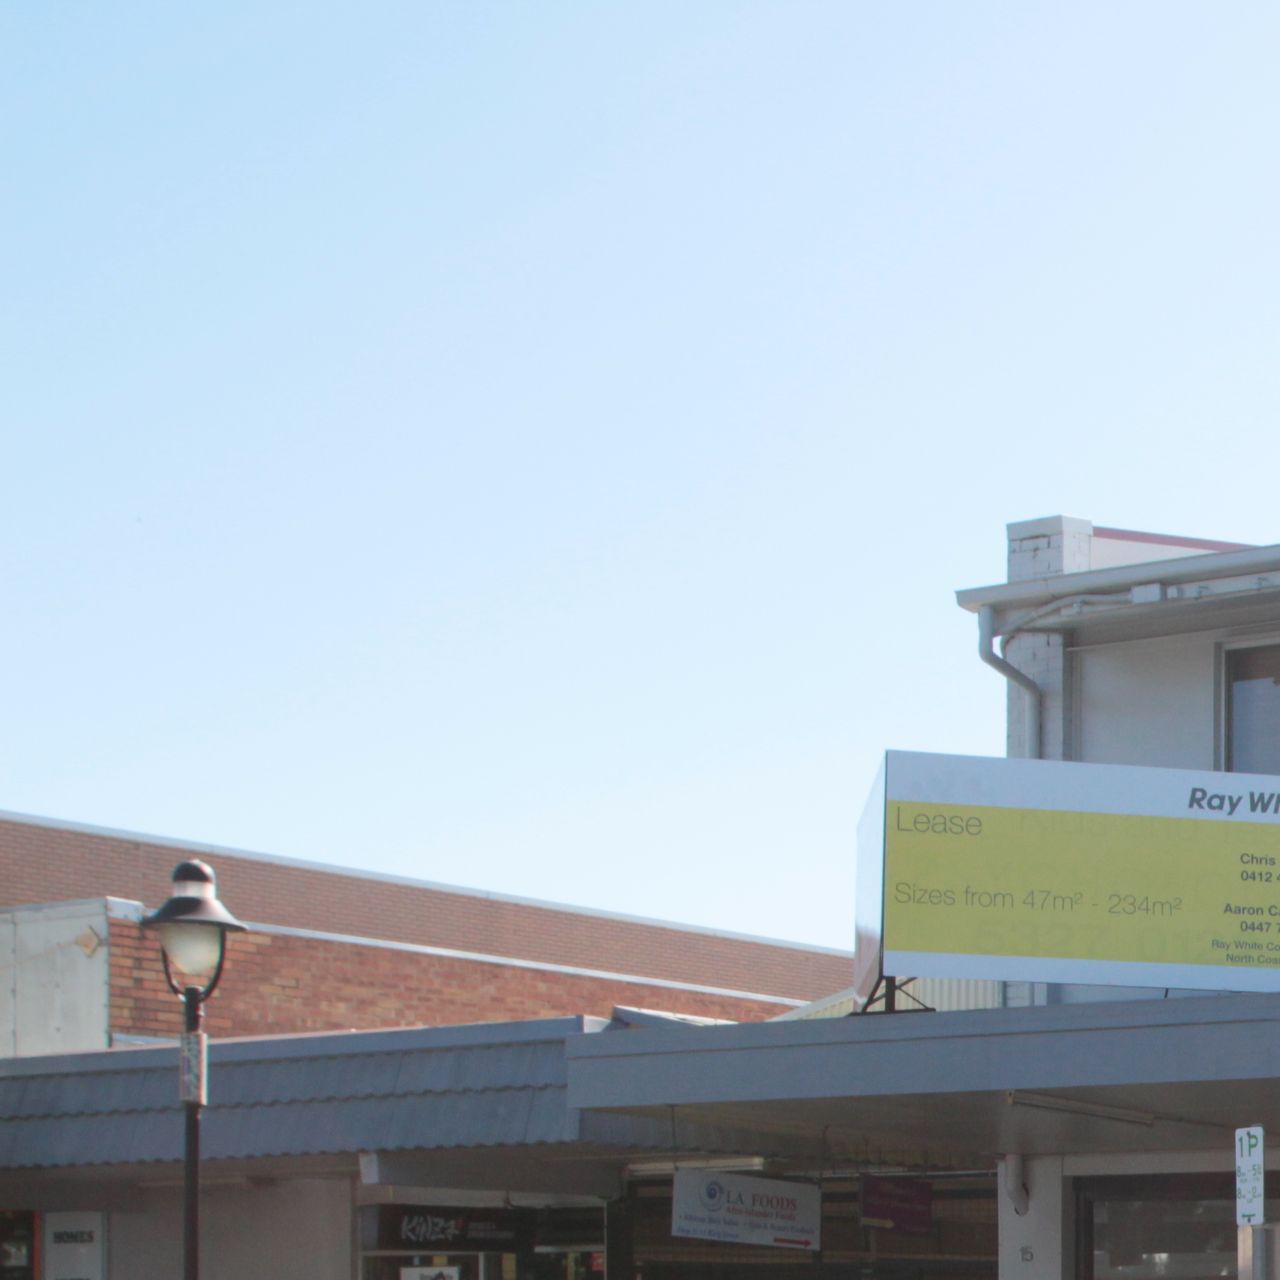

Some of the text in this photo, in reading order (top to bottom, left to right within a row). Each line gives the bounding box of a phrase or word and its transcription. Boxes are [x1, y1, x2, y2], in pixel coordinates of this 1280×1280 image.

[1188, 787, 1243, 816] Ray
[896, 806, 983, 836] Lease
[1240, 852, 1276, 867] Chris
[1240, 870, 1273, 884] 0412
[894, 882, 957, 907] Sizes
[964, 885, 1015, 909] from
[1223, 903, 1264, 917] Aaron
[1240, 920, 1272, 934] 0447
[1211, 939, 1230, 952] Ray
[1234, 940, 1263, 952] White
[1226, 954, 1255, 964] North
[752, 1194, 798, 1211] FOODS
[53, 1230, 94, 1244] HOMES
